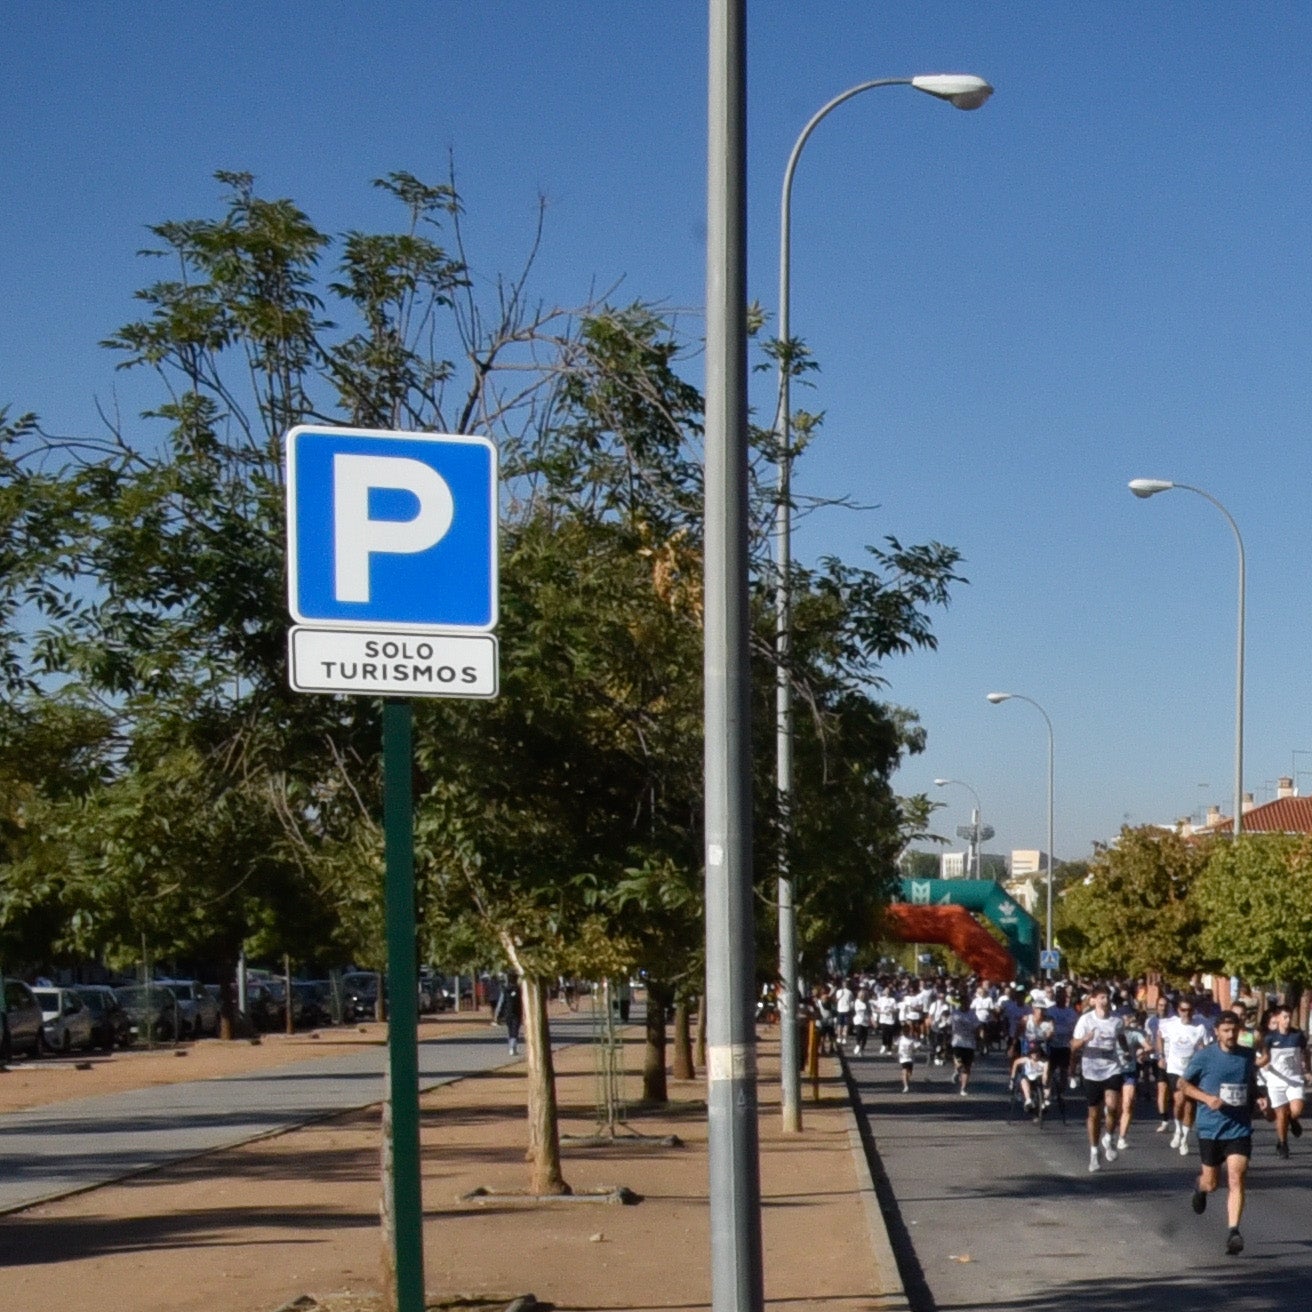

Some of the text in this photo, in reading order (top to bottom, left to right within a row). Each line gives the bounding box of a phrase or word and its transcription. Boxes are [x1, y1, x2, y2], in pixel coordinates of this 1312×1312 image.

[334, 453, 453, 602] P
[364, 641, 433, 660] SOLO
[321, 661, 478, 684] TURISMOS
